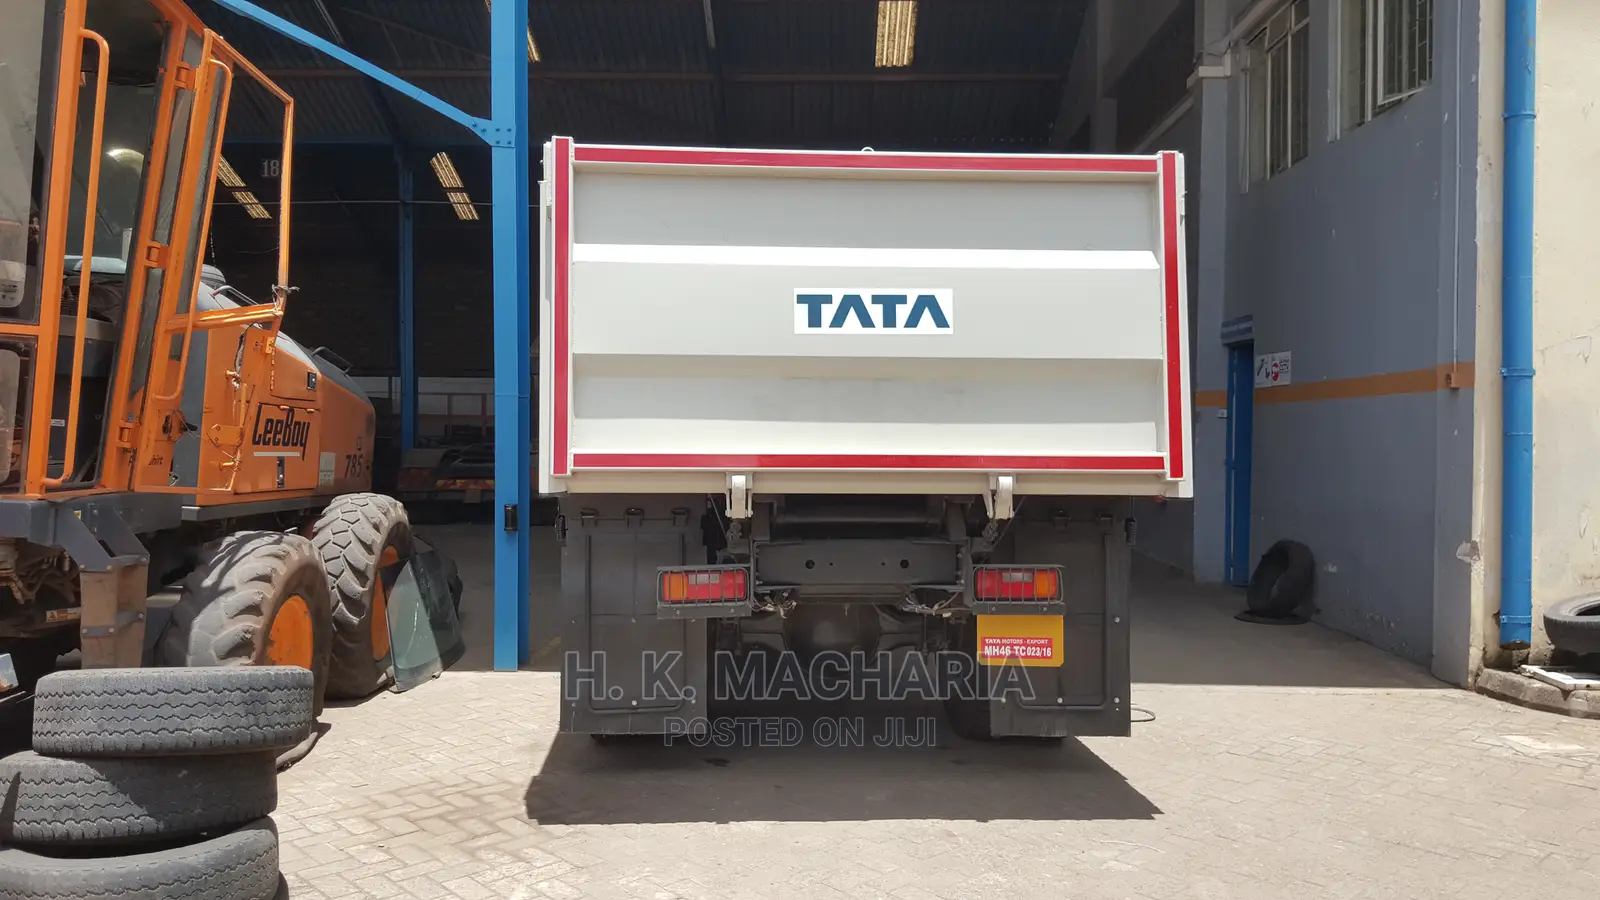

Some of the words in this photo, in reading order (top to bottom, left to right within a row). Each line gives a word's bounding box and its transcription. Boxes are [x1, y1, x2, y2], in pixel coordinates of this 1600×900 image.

[262, 159, 280, 177] 18
[796, 294, 950, 328] TATA
[252, 404, 310, 461] LeeBoy
[984, 646, 1011, 656] MH46
